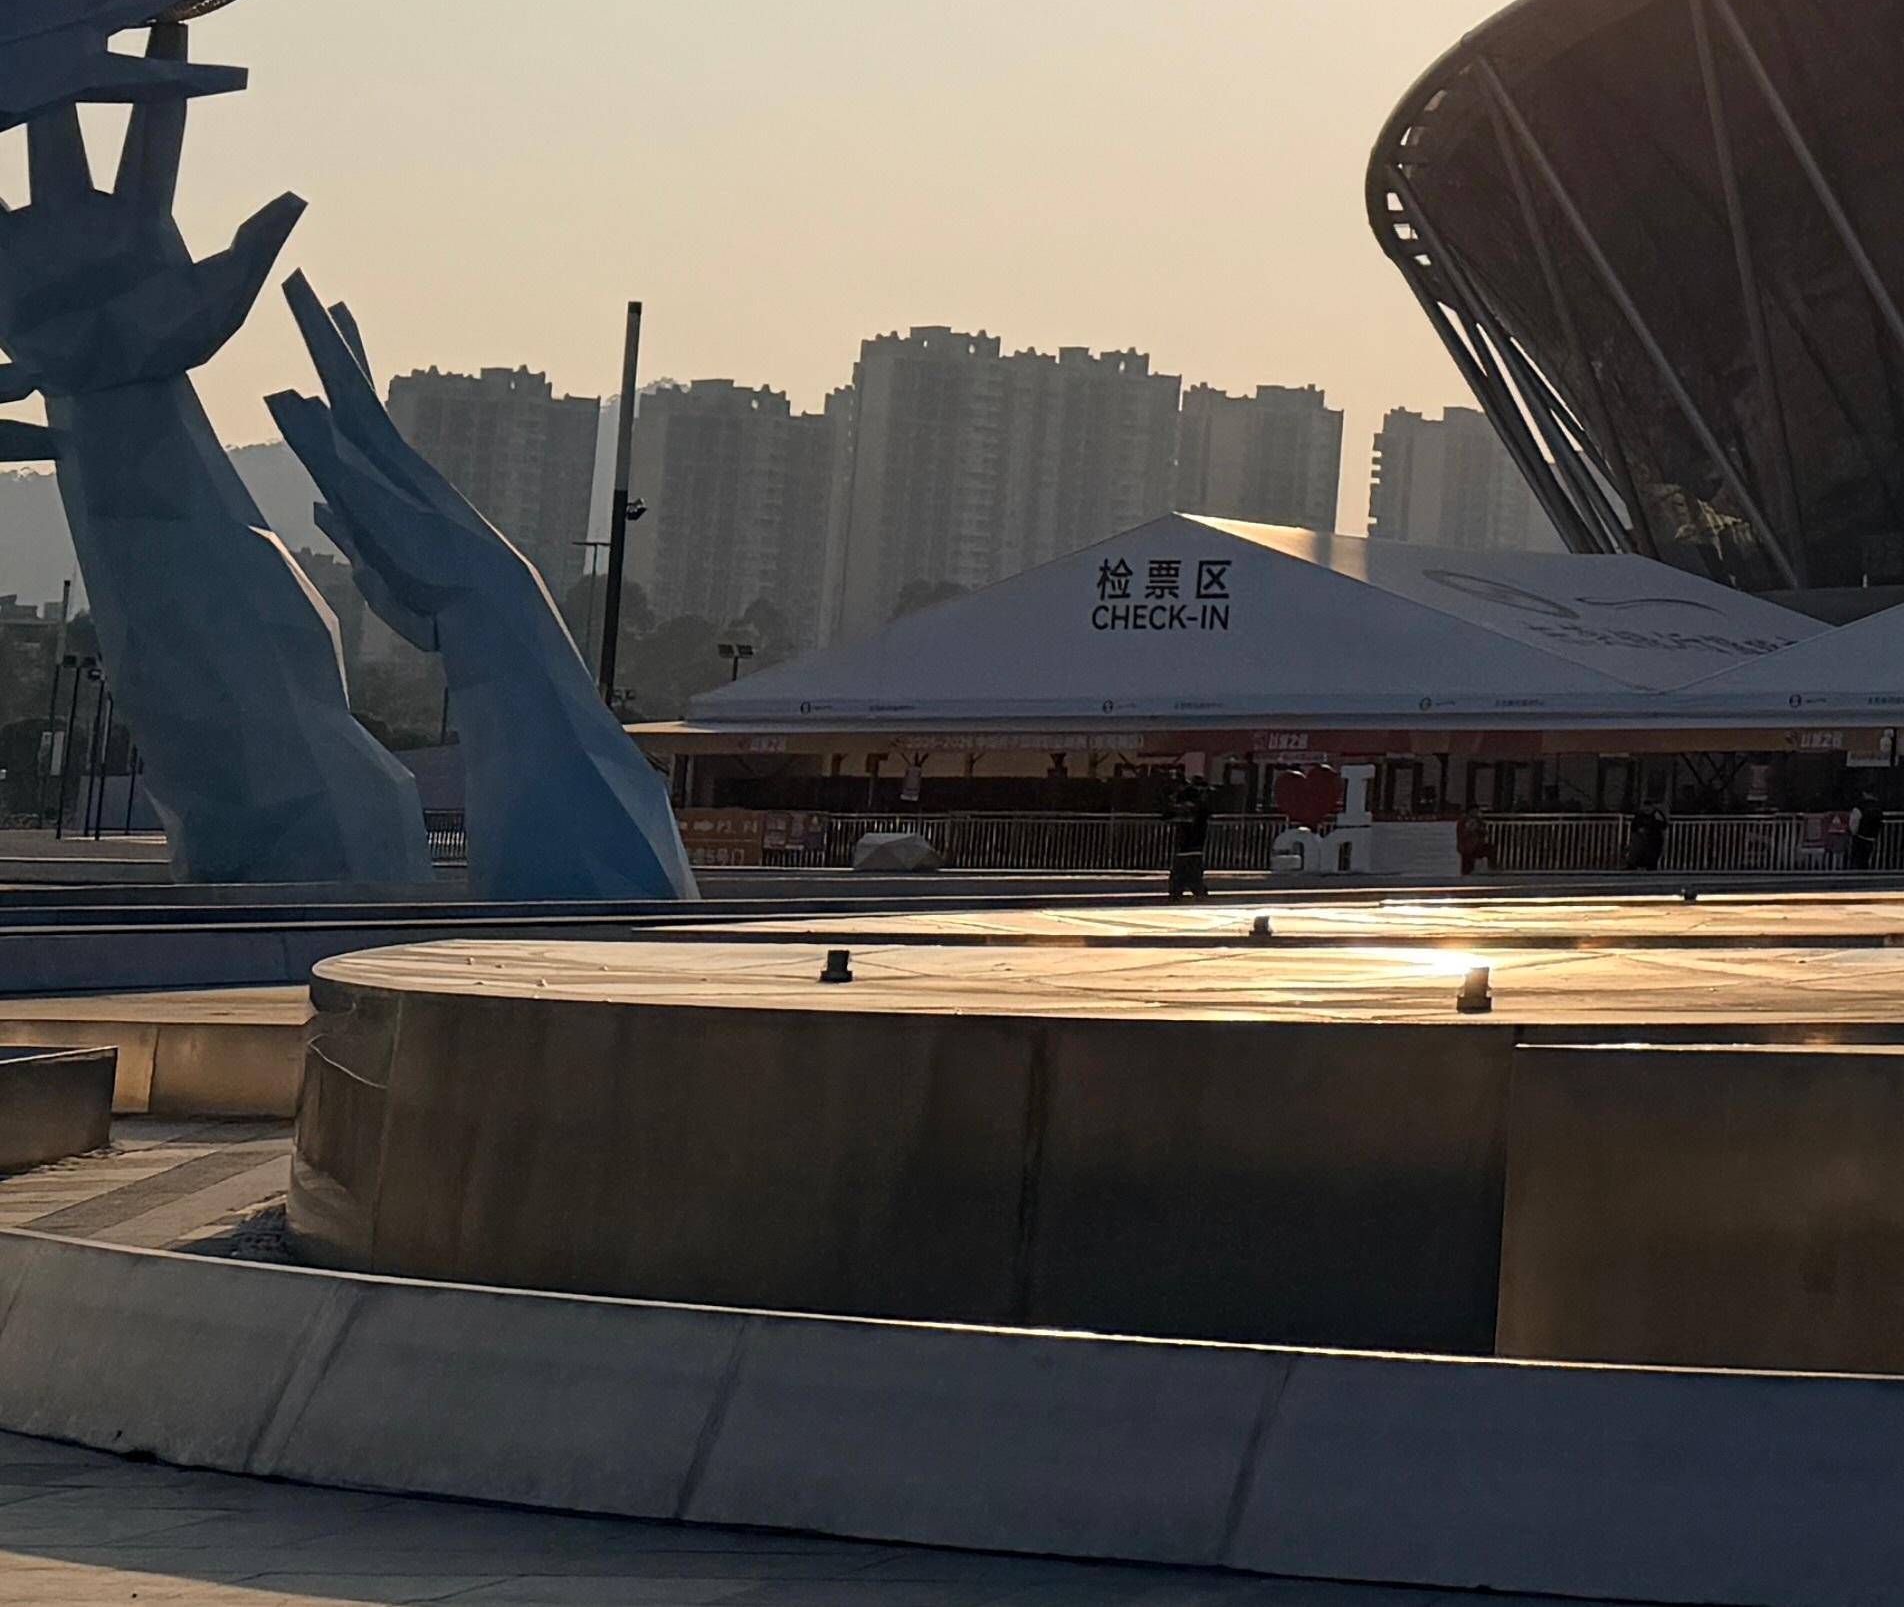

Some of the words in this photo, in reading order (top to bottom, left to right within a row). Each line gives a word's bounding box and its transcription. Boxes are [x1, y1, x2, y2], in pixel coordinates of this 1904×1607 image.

[1097, 559, 1233, 600] 检票区
[1092, 605, 1230, 631] CHECK-IN
